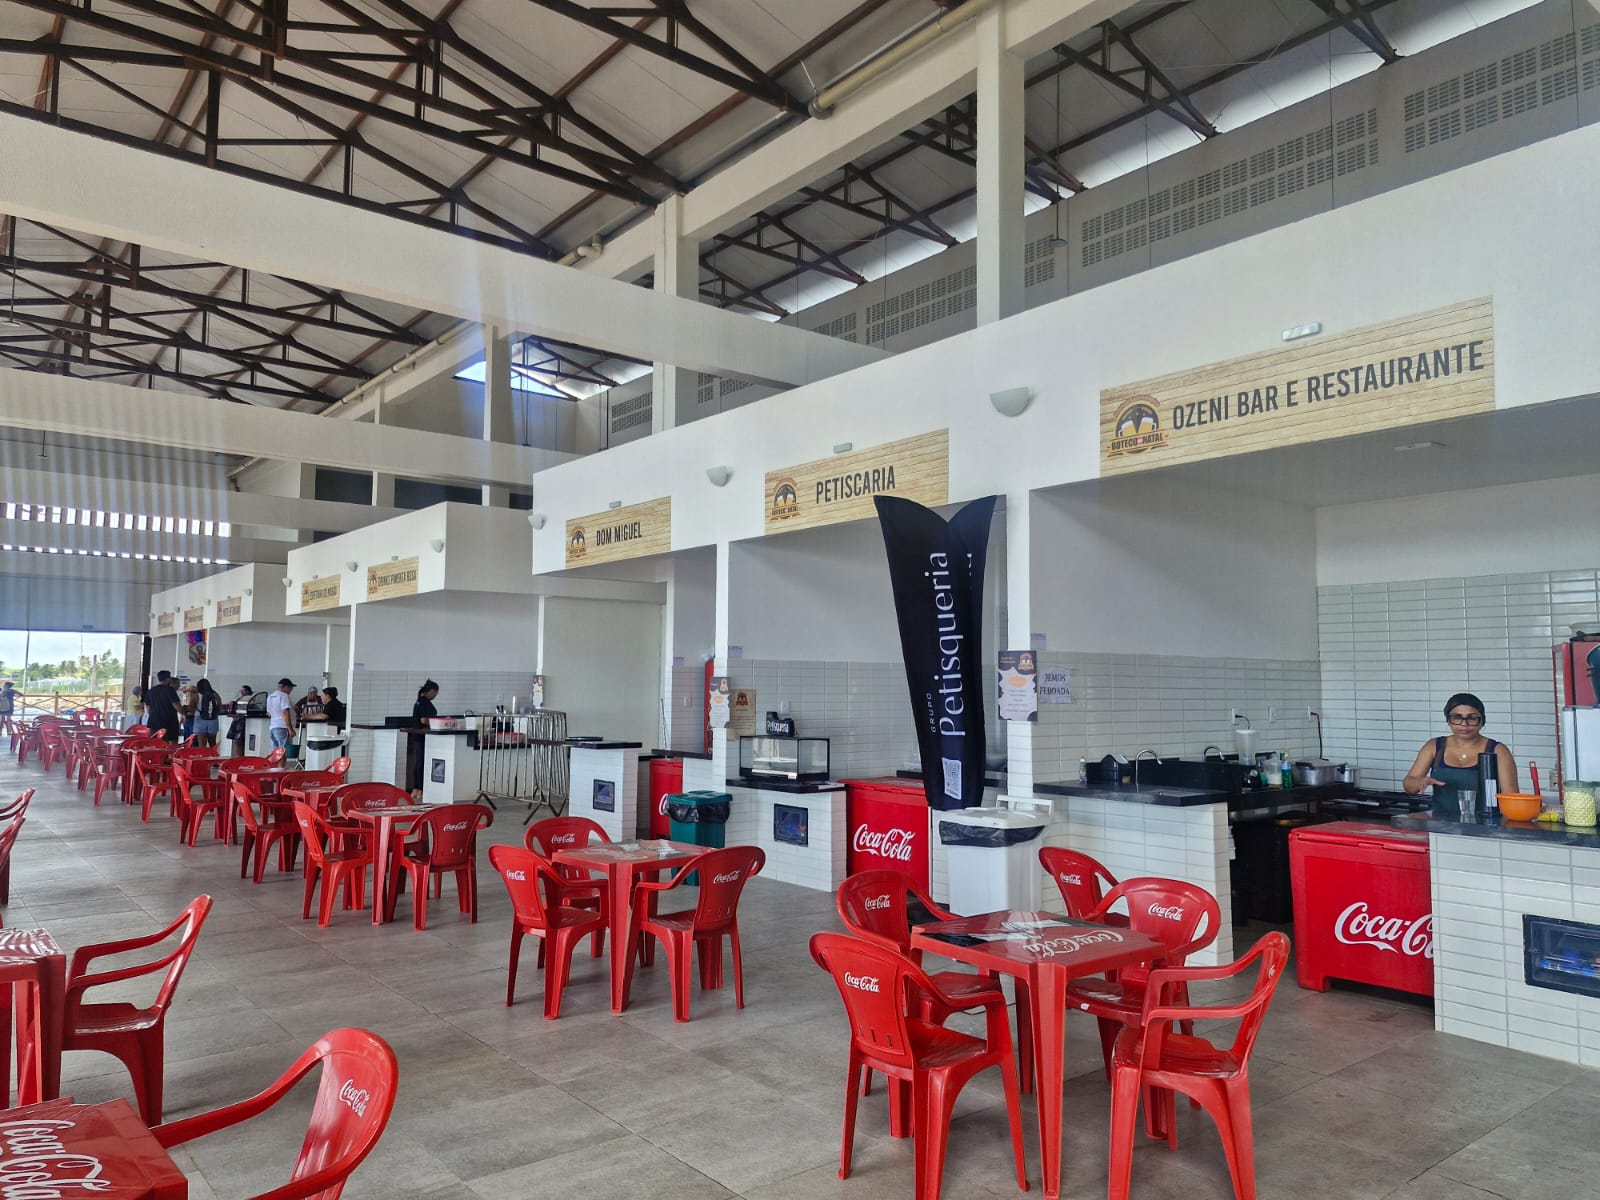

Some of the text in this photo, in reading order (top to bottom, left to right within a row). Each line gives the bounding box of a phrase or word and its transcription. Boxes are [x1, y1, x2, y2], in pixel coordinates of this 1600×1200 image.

[1173, 395, 1229, 430] OZENI
[1237, 384, 1279, 418] BAR
[1286, 380, 1299, 408] E
[1307, 340, 1485, 404] RESTAURANTE
[816, 466, 896, 504] PETISCARIA
[596, 522, 642, 546] DOM MIGUEL
[924, 552, 966, 737] Petisqueria
[925, 692, 936, 734] GRUPO
[853, 823, 916, 861] Coca-Cola
